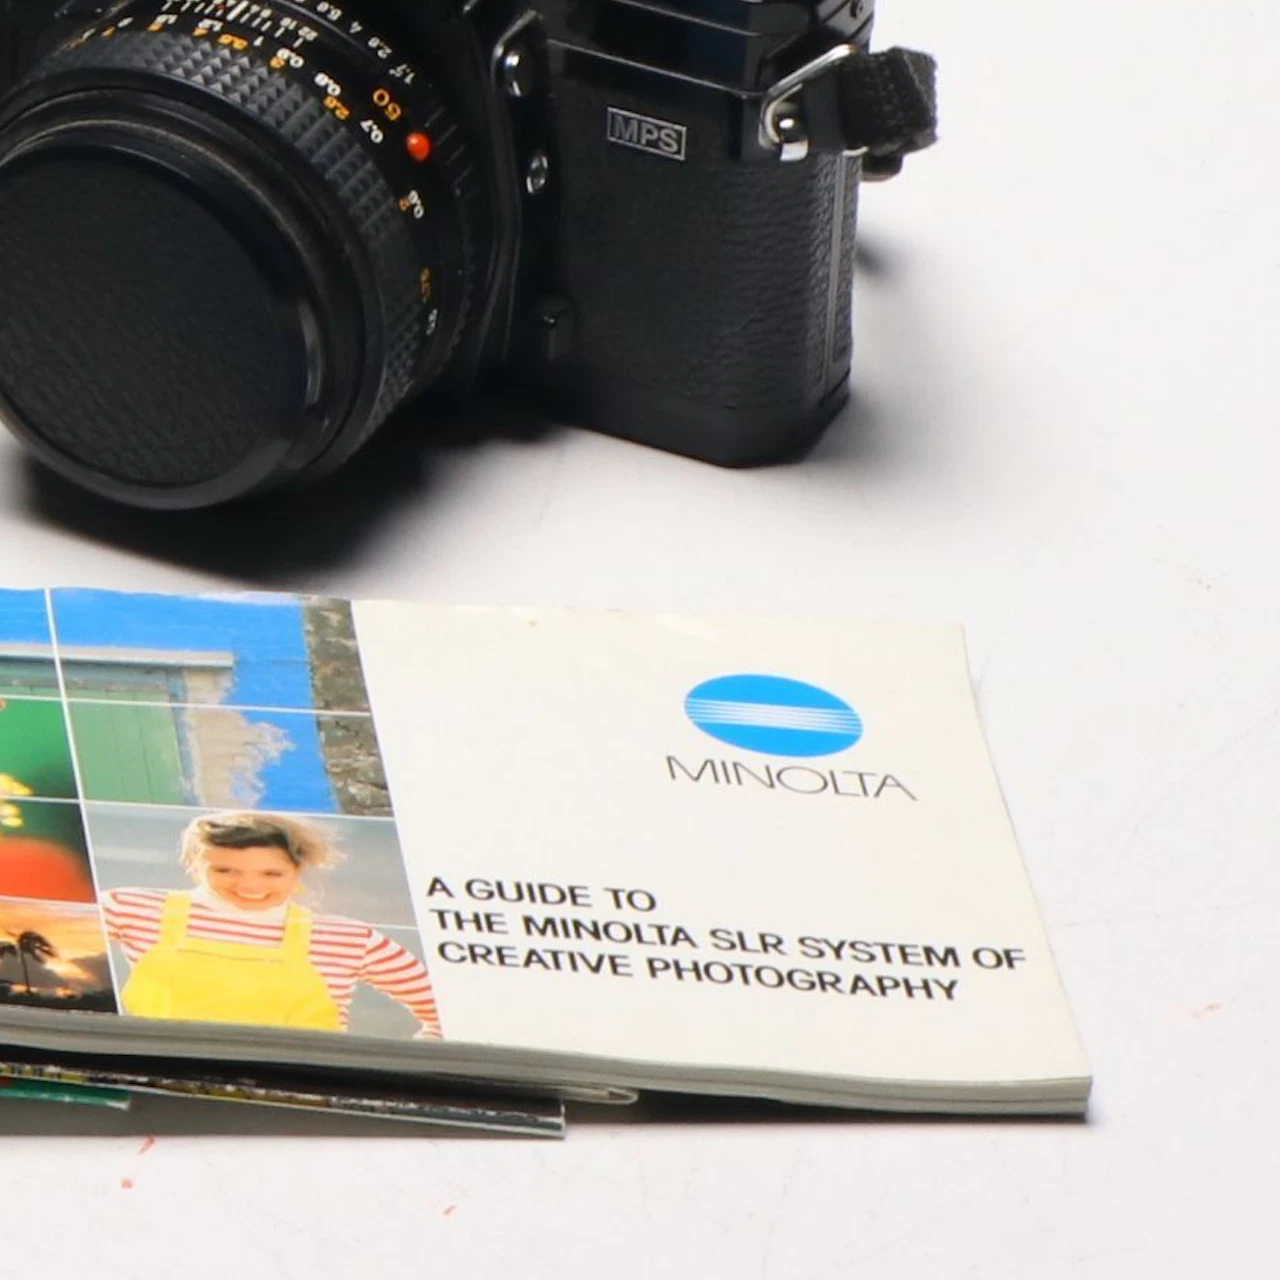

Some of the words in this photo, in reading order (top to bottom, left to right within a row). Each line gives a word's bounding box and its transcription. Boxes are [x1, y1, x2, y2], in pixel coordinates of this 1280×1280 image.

[371, 88, 403, 122] 50
[612, 114, 679, 154] MPS
[666, 754, 919, 803] MINOLTA
[426, 875, 455, 899] A
[463, 877, 594, 908] GUIDE
[602, 886, 657, 914] TO
[429, 908, 510, 935] THE
[522, 913, 700, 950] MINOLTA
[707, 926, 788, 958] SLR
[796, 935, 963, 970] SYSTEM
[970, 946, 1028, 972] OF
[436, 941, 636, 978] CREATIVE
[647, 956, 962, 1002] PHOTOGRAPHY
